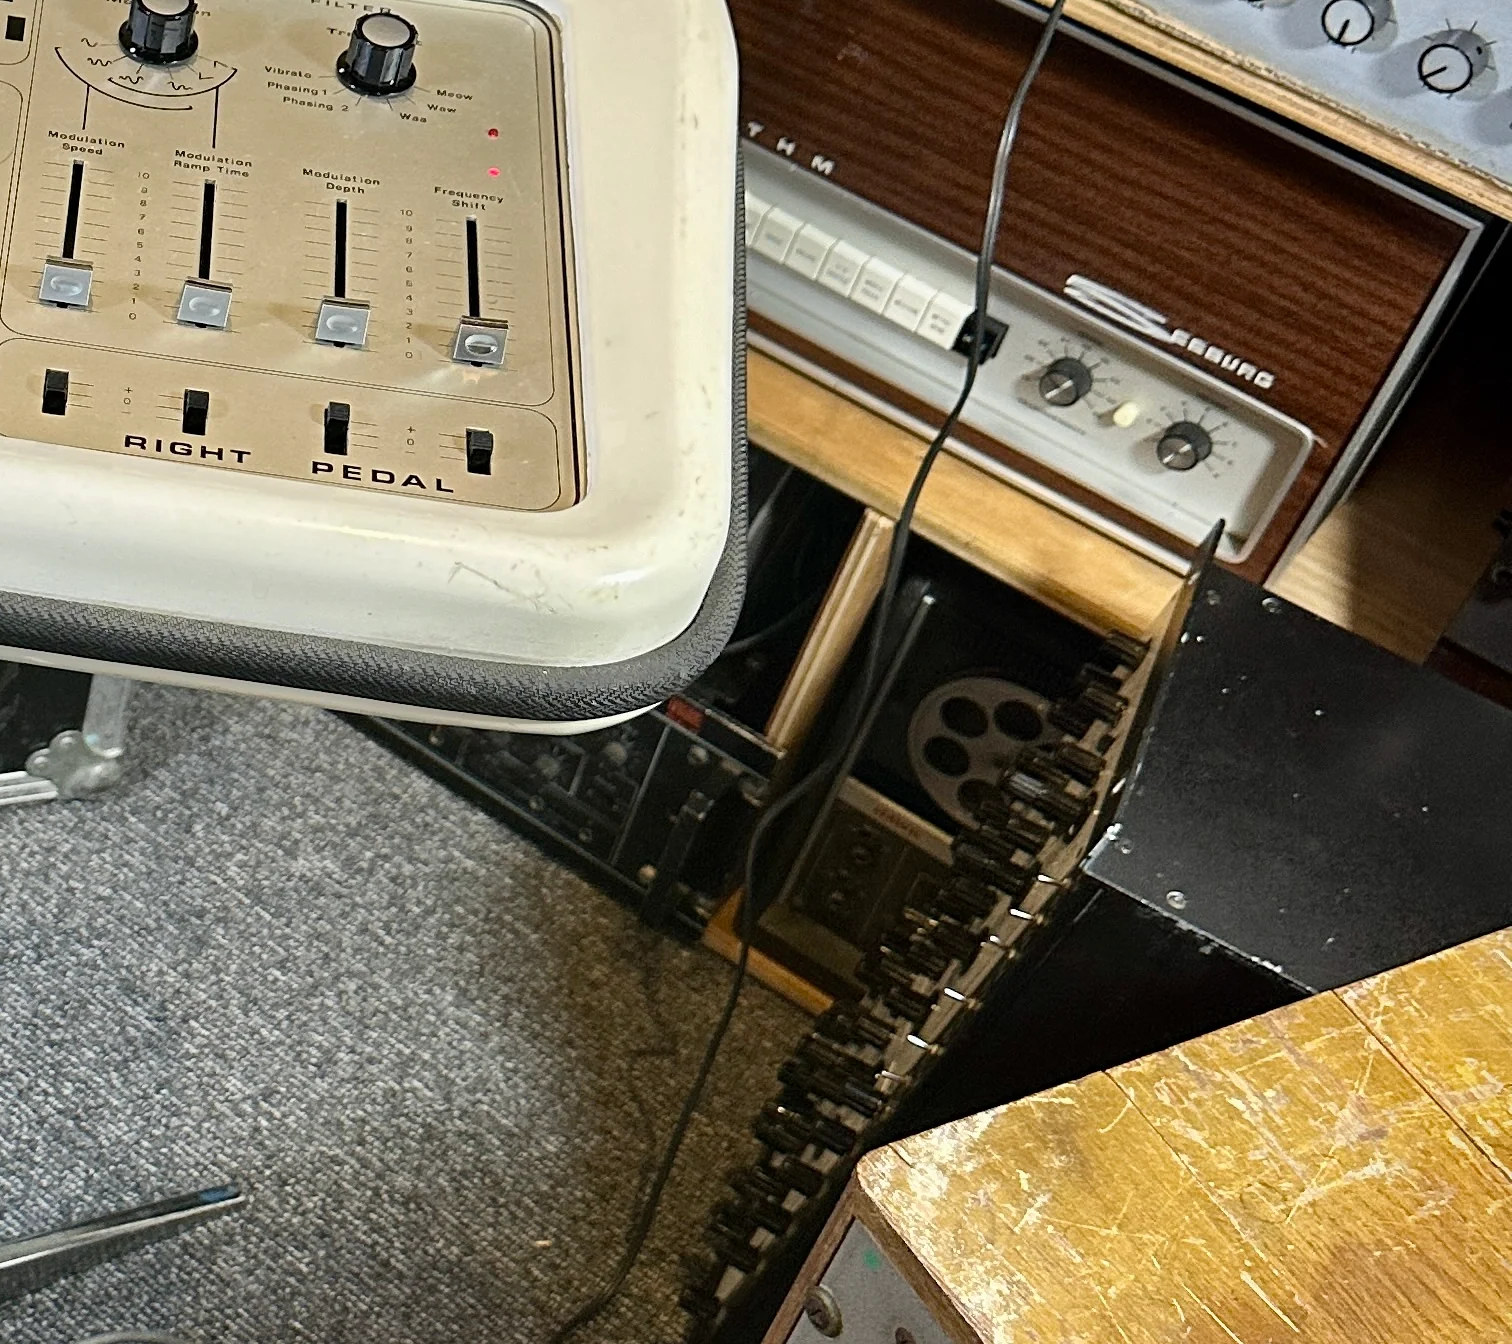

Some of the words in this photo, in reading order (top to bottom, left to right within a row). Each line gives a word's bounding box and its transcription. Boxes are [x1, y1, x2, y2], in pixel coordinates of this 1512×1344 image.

[264, 65, 312, 79] Vibrato
[267, 81, 319, 96] Phasing
[282, 96, 334, 111] Phasing
[427, 103, 457, 114] Waw
[399, 111, 428, 124] Waa
[48, 130, 125, 149] Modulation
[62, 142, 103, 156] Speed
[747, 120, 835, 176] THM
[175, 149, 253, 168] Modulation
[173, 159, 211, 173] Ramp
[217, 165, 250, 178] Time
[302, 167, 381, 186] Modulation
[326, 182, 365, 195] Depth
[434, 186, 504, 204] Frequency
[451, 199, 487, 211] Shift
[124, 434, 251, 464] RIGHT
[312, 460, 454, 493] PEDAL
